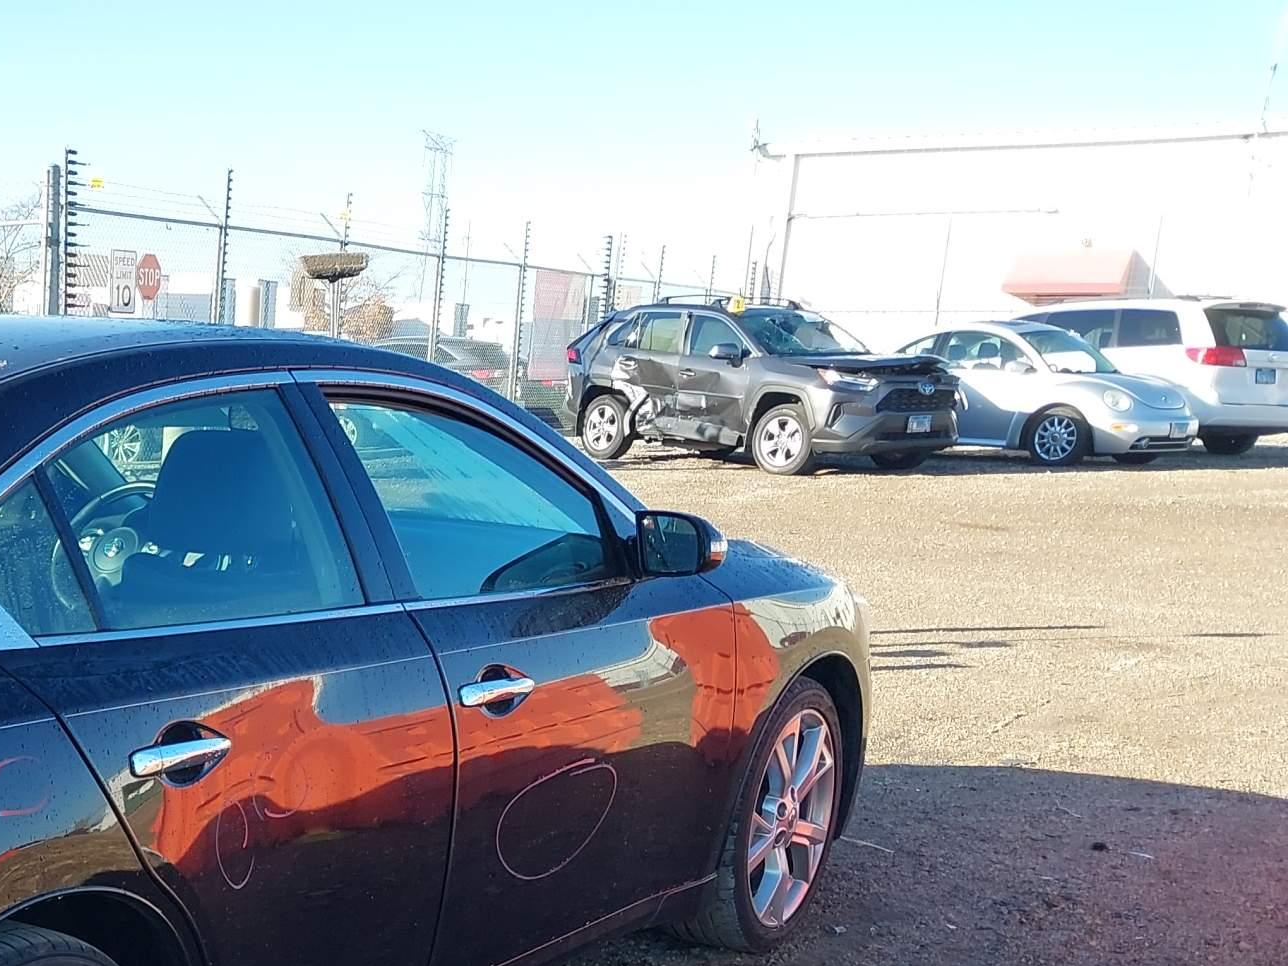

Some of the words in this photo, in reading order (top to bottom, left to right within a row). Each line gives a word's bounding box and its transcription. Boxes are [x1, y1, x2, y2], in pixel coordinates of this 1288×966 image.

[114, 256, 134, 267] SPEED
[116, 271, 132, 280] LIMIT
[138, 268, 161, 287] STOP
[116, 284, 132, 307] 10
